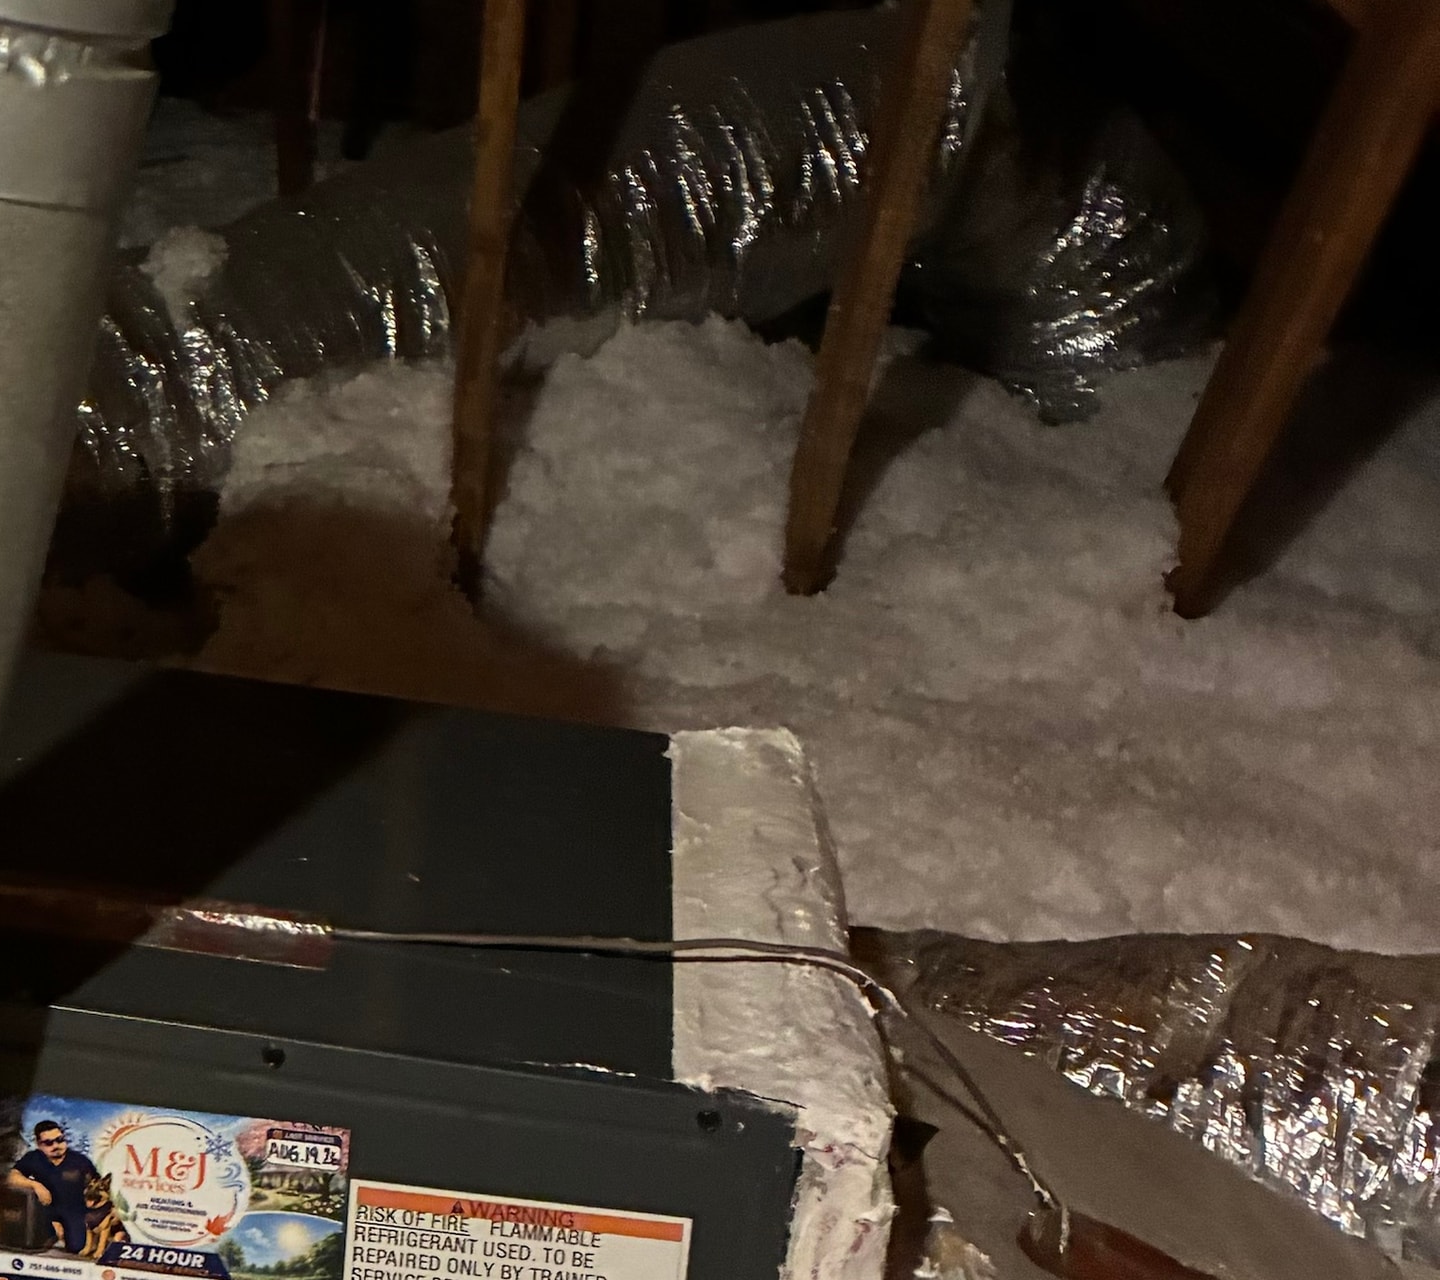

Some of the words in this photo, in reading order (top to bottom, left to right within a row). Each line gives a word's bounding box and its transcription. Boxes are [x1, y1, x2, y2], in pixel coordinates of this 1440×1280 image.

[355, 1203, 398, 1224] RISK
[401, 1209, 426, 1227] OF
[430, 1212, 470, 1233] FIRE
[489, 1219, 602, 1248] FLAMMABLE
[468, 1200, 574, 1229] WARNING
[119, 1246, 143, 1260] 24
[147, 1249, 205, 1268] HOUR
[351, 1245, 441, 1272] REPAIRED
[446, 1256, 495, 1278] ONLY
[499, 1263, 524, 1280] BY
[353, 1224, 478, 1254] REFRIGERANT
[482, 1240, 536, 1262] USED.
[542, 1246, 566, 1266] TO
[570, 1250, 595, 1269] BE
